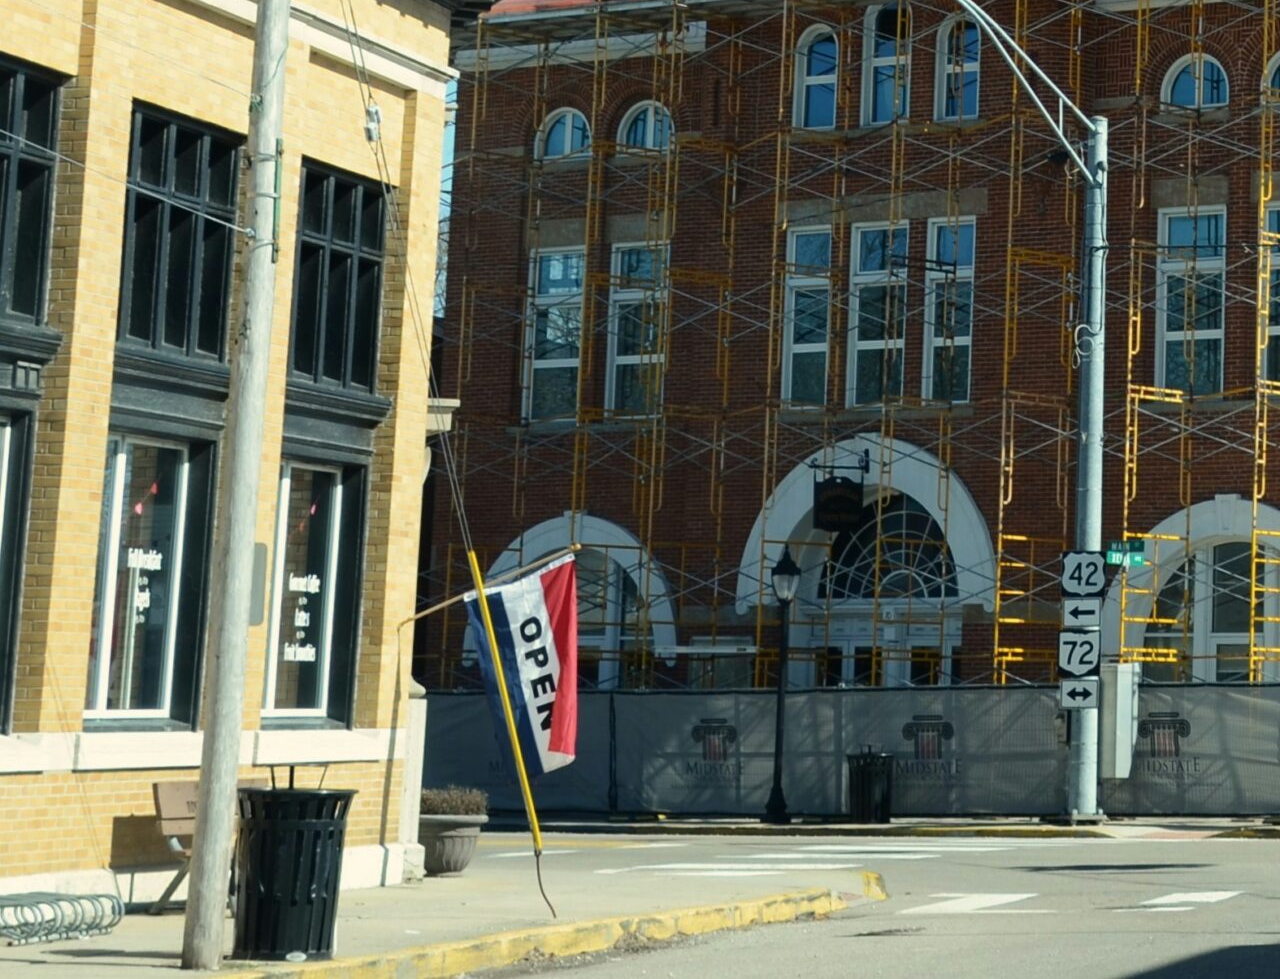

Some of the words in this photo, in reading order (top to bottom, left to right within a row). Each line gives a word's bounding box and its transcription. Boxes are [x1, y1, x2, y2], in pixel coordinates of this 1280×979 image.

[1068, 561, 1099, 587] 42
[1062, 640, 1094, 665] 72
[520, 616, 557, 731] OPEN
[895, 758, 962, 774] MIDSTATE
